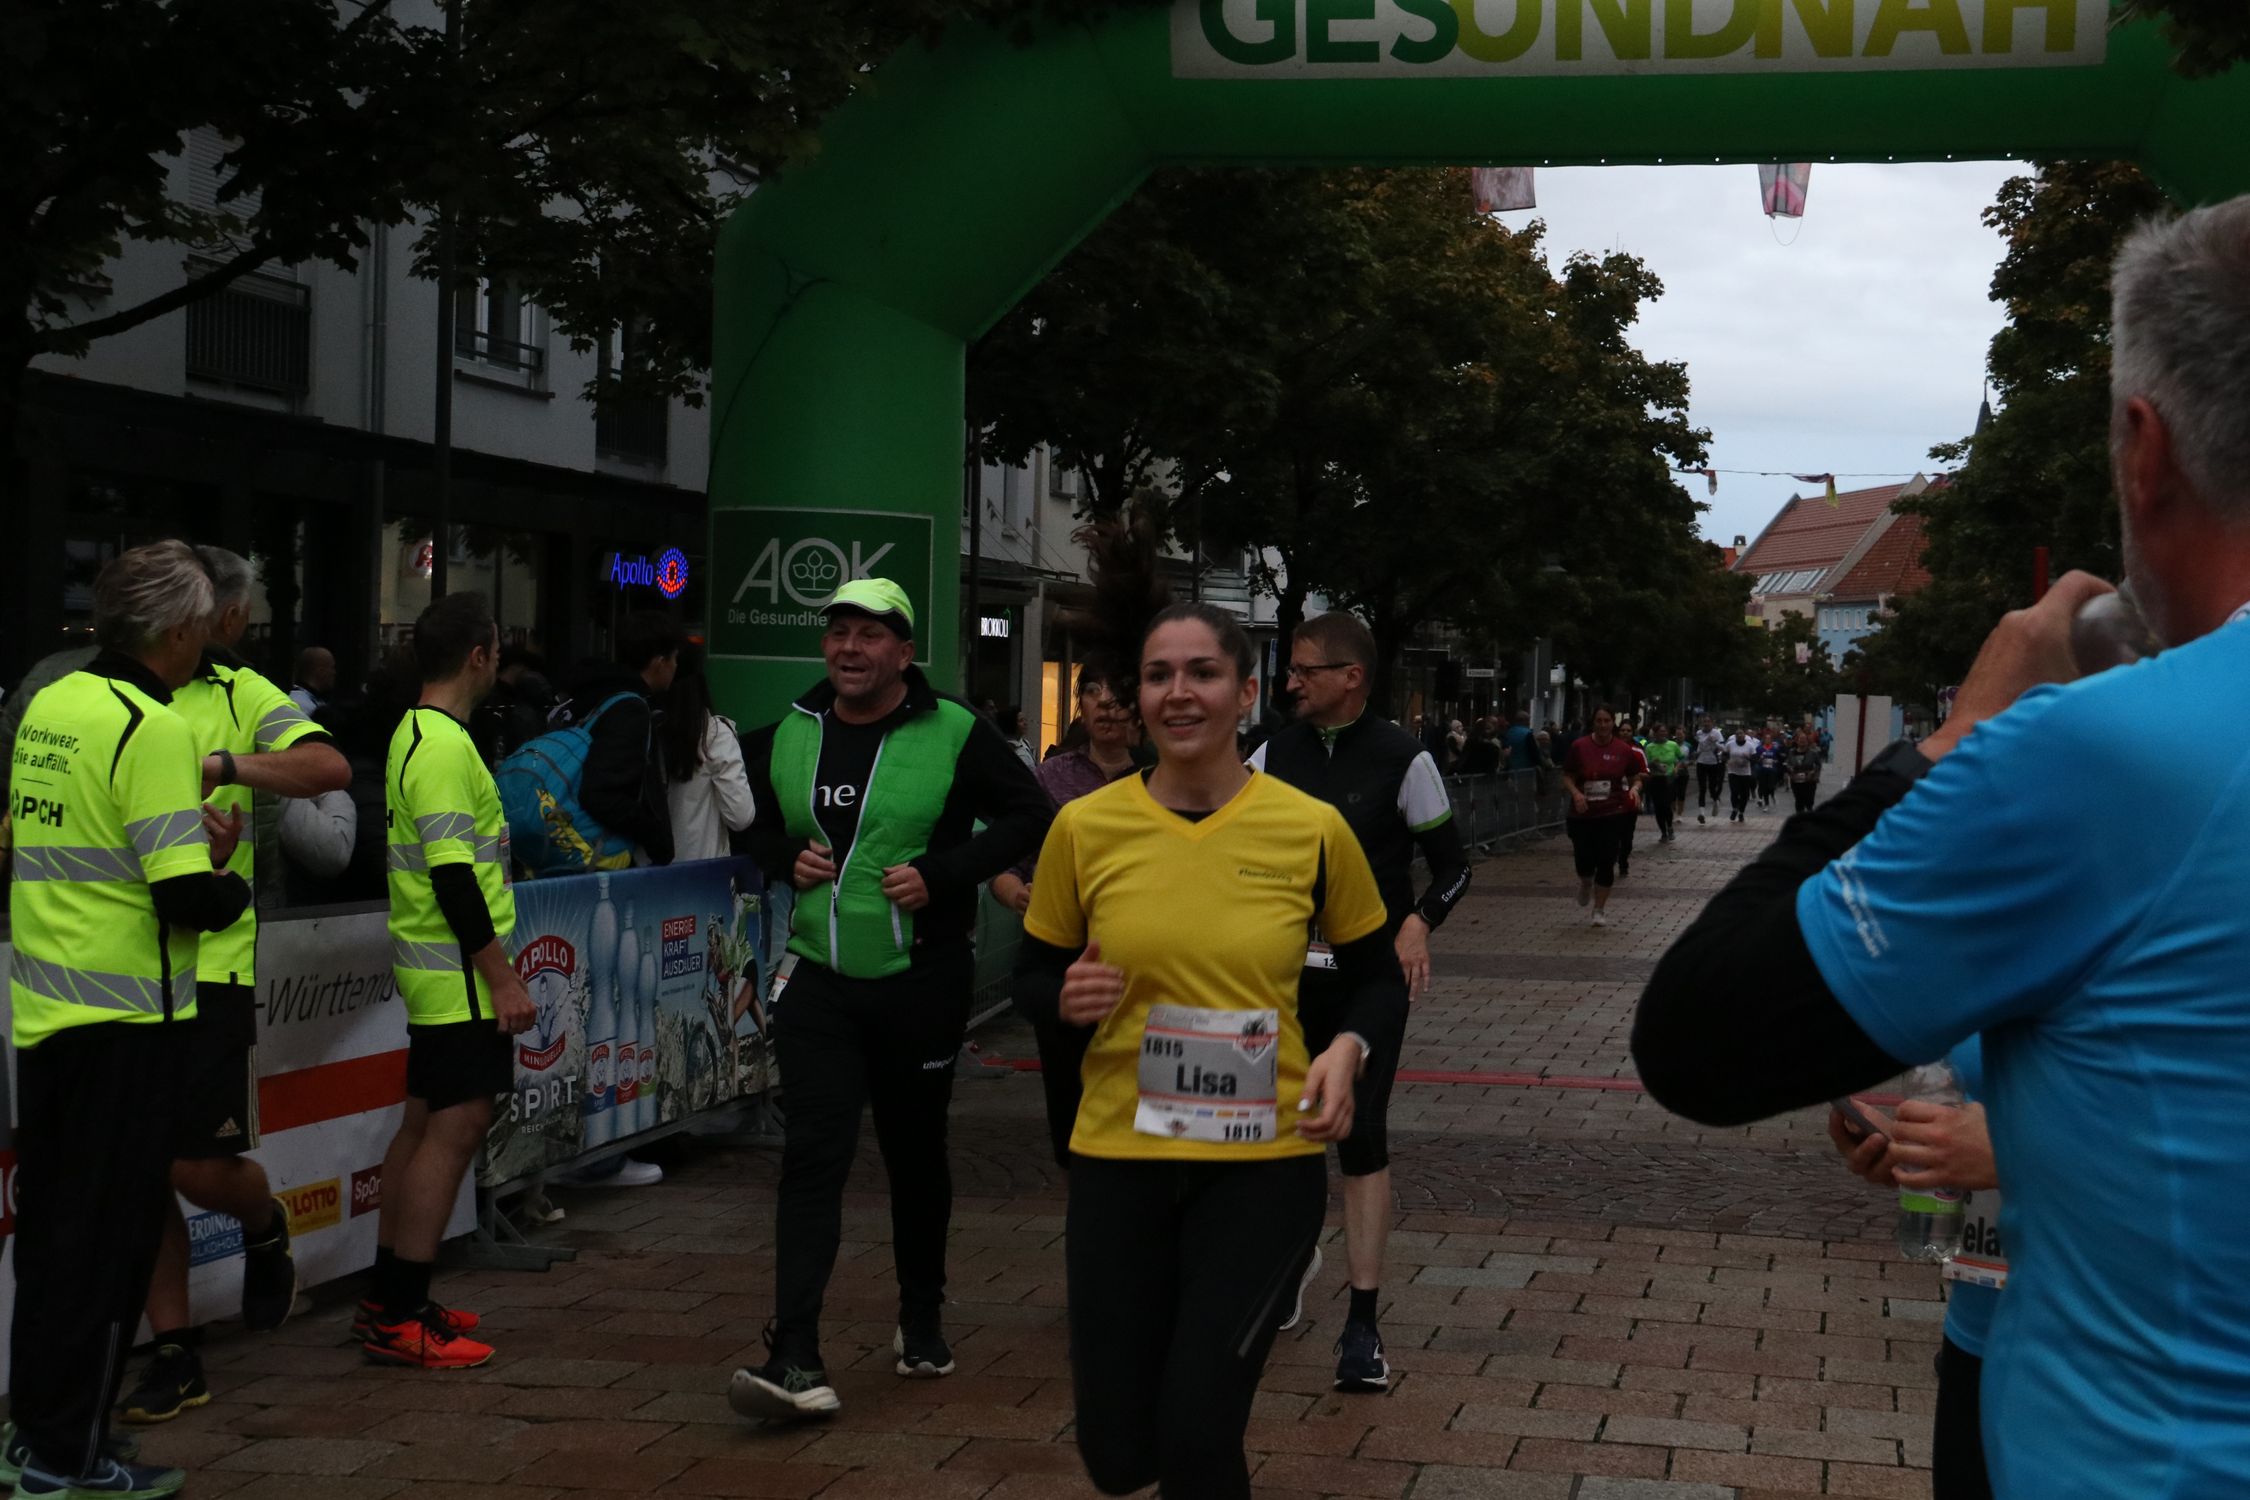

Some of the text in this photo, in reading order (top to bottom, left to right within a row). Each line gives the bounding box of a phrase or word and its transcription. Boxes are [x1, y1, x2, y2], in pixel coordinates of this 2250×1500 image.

[610, 552, 654, 592] Apollo
[732, 537, 896, 607] AOK
[728, 609, 746, 624] Die
[20, 725, 80, 754] Workwear,
[520, 942, 568, 978] APOLLO
[255, 967, 402, 1026] -Württemb
[1145, 1038, 1183, 1058] 1815
[1176, 1064, 1237, 1096] Lisa
[1224, 1123, 1262, 1141] 1815
[292, 1186, 338, 1217] LOTTO
[189, 1213, 242, 1241] ERDINGE
